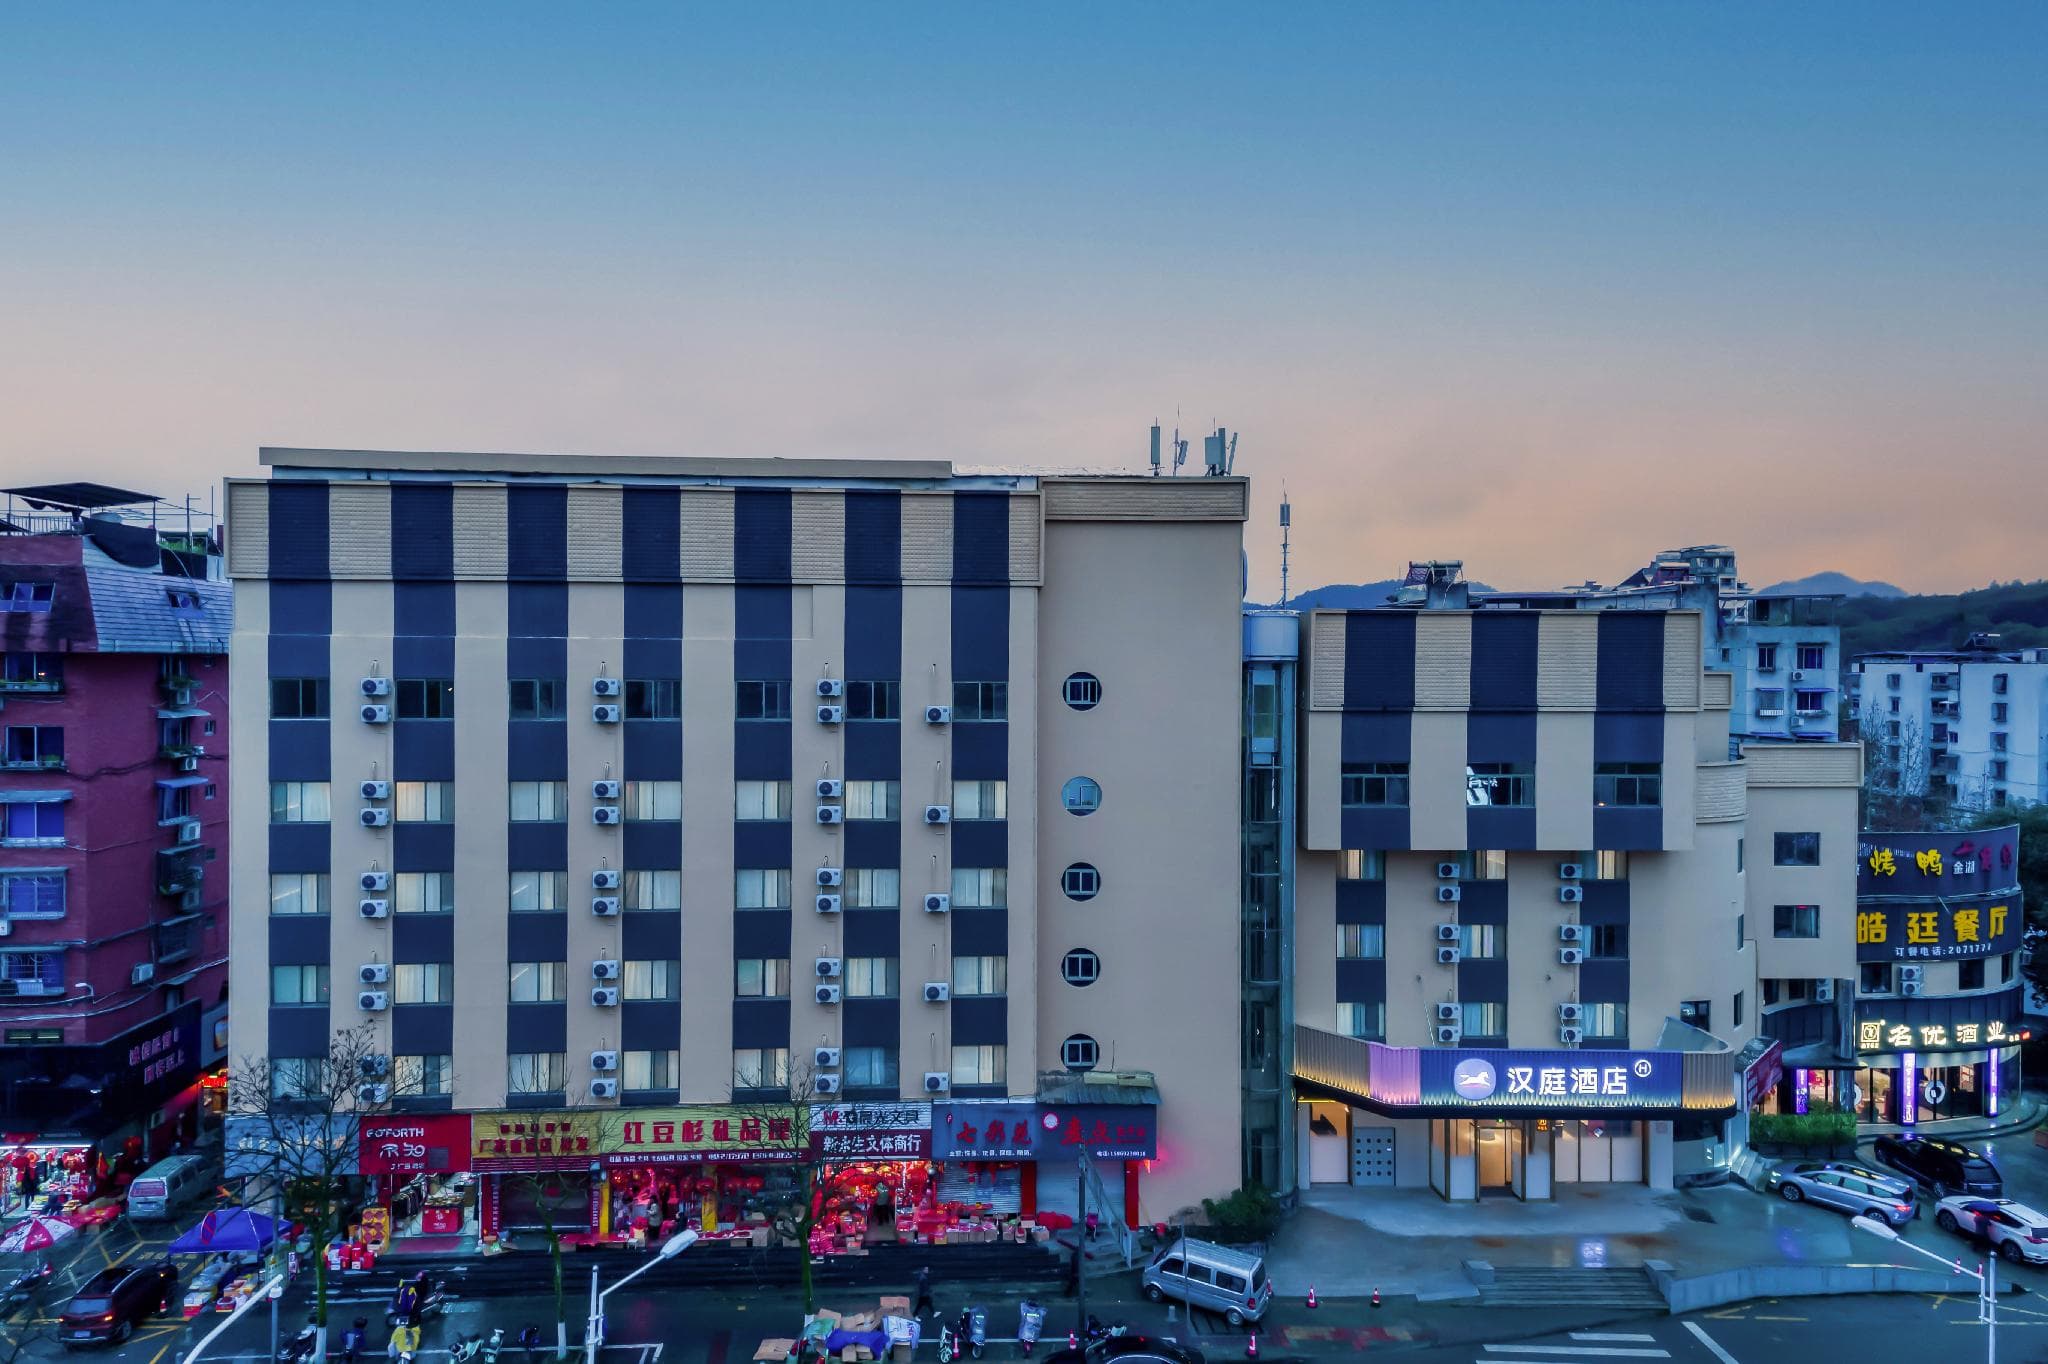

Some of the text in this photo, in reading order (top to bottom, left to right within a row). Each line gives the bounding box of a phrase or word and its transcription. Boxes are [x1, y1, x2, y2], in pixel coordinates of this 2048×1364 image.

[1870, 848, 1942, 876] 烤鸭
[1888, 1020, 2005, 1047] 名优酒业
[1507, 1067, 1627, 1095] 汉庭酒店
